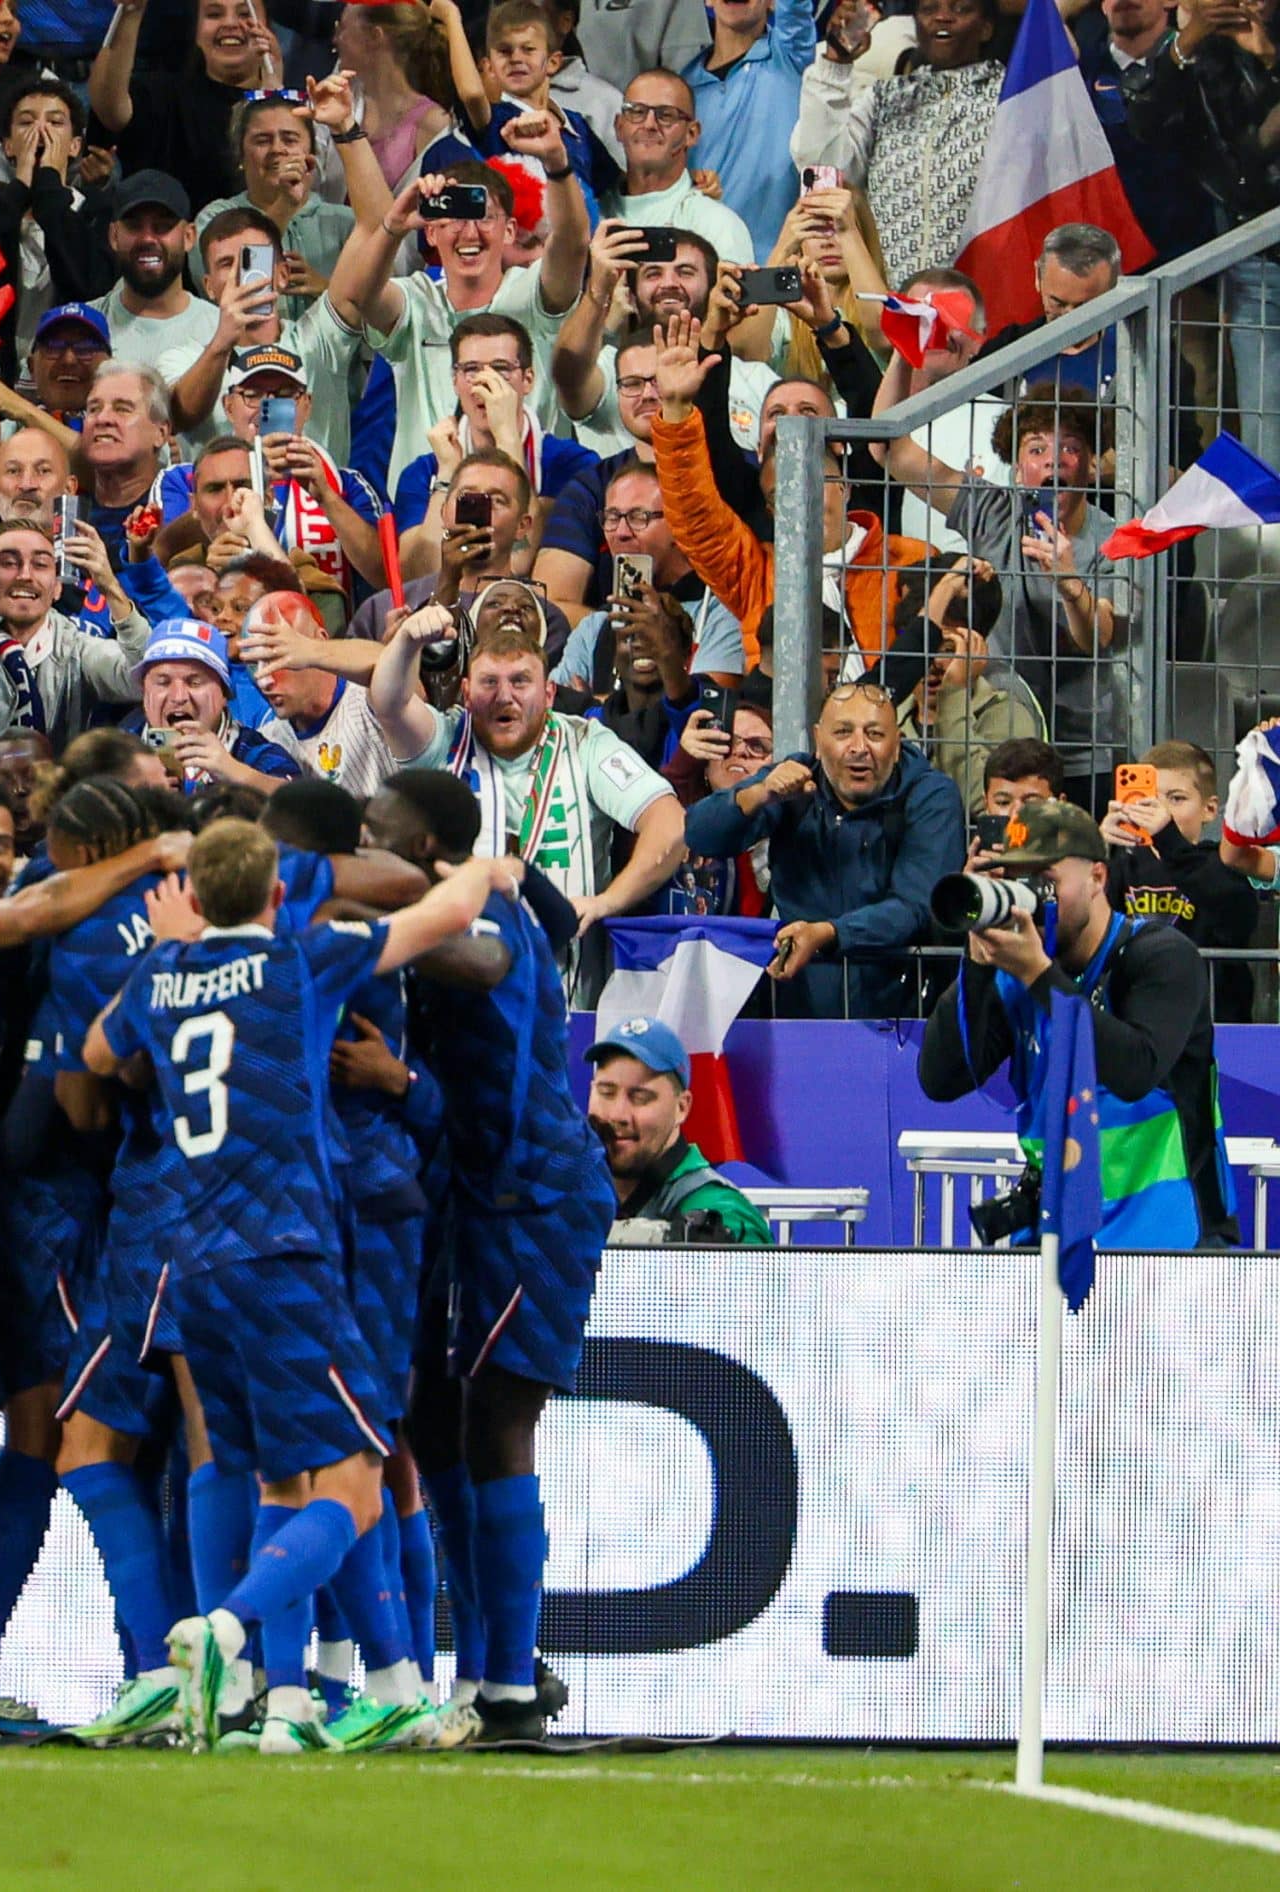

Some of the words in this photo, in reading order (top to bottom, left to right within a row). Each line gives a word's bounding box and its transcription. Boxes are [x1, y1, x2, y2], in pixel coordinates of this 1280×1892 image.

[117, 913, 157, 956] JA
[150, 953, 269, 1010] TRUFFERT
[171, 1010, 236, 1159] 3
